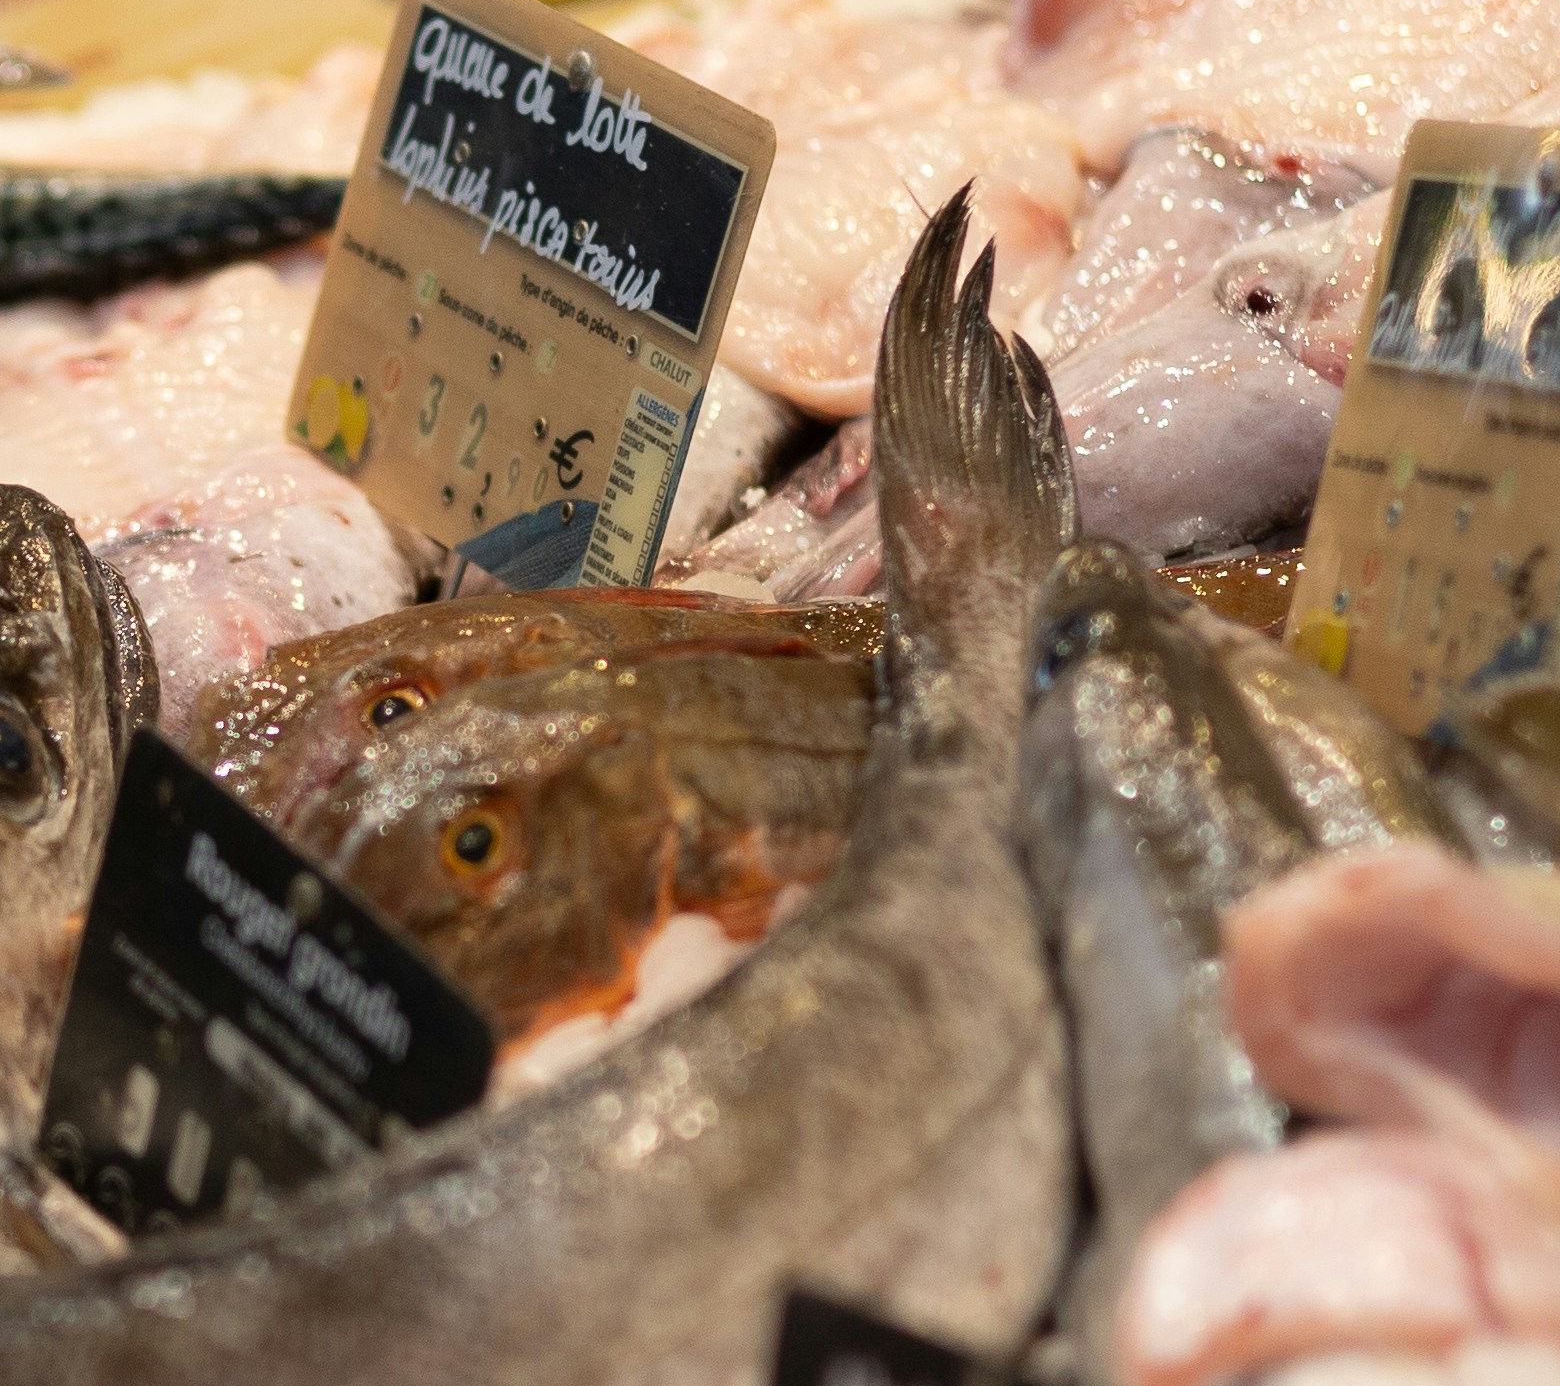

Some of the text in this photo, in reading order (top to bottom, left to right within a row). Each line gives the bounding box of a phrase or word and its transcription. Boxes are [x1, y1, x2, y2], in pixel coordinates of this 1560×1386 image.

[515, 56, 556, 125] de
[520, 273, 541, 301] Type
[577, 307, 589, 325] de
[649, 350, 693, 388] CHALUT
[549, 430, 595, 490] €
